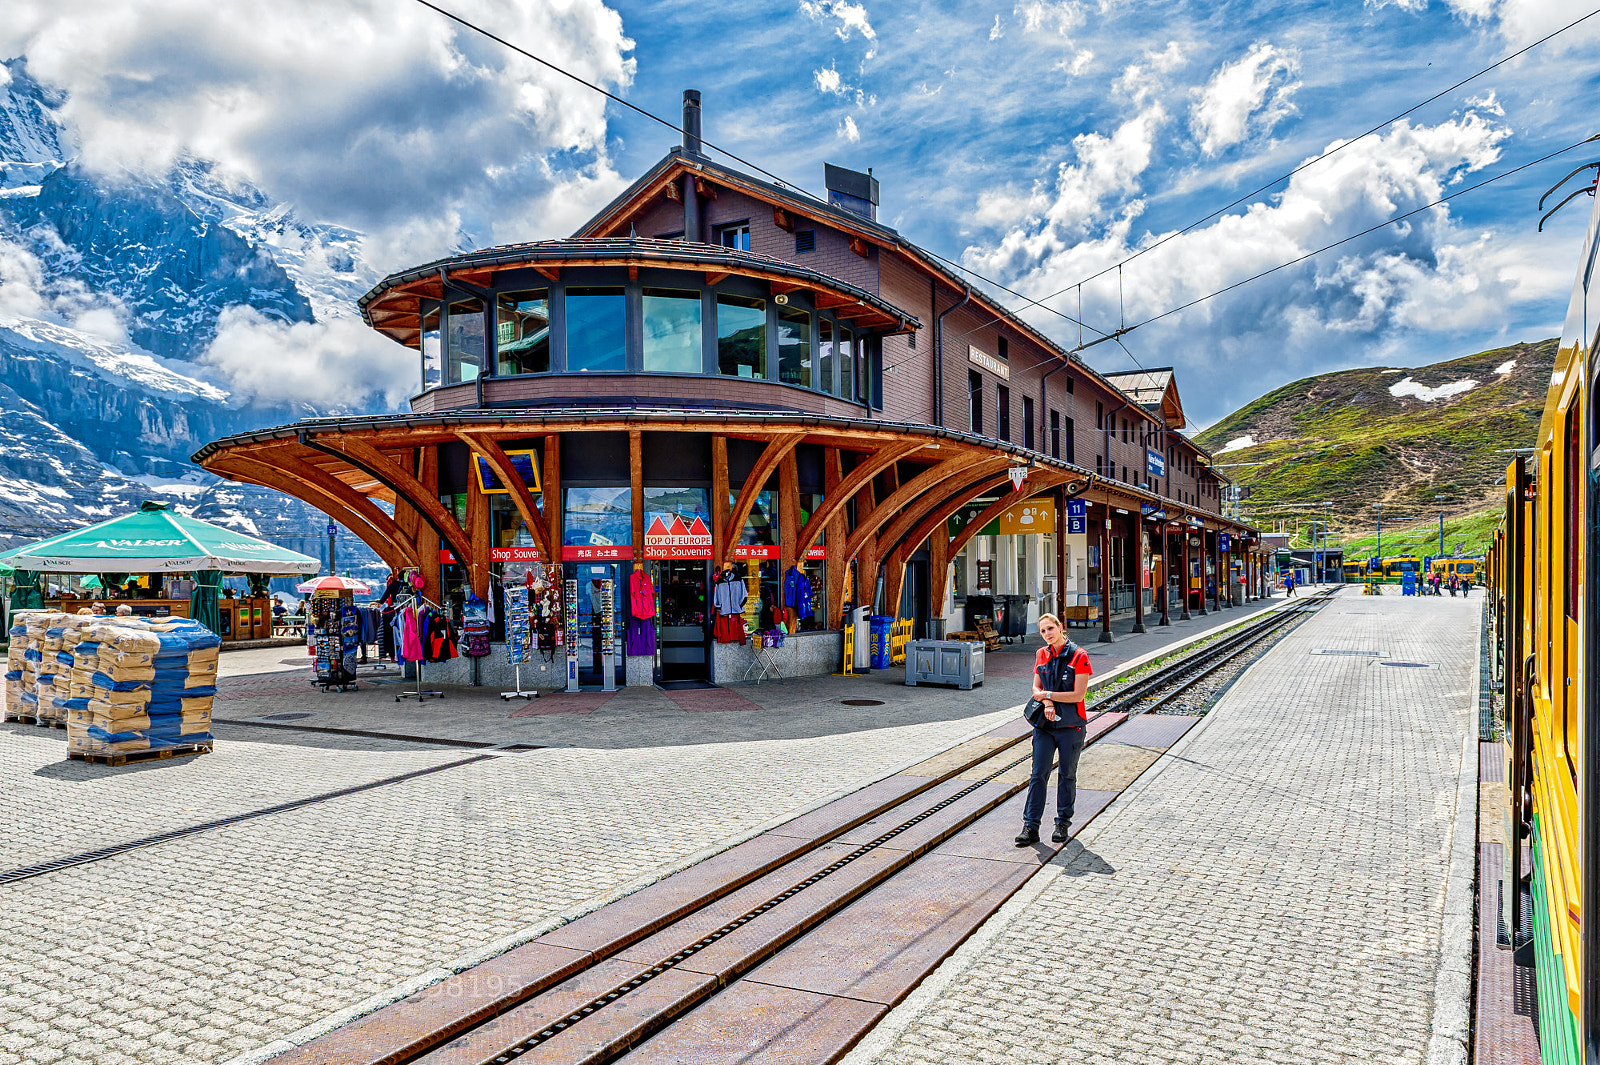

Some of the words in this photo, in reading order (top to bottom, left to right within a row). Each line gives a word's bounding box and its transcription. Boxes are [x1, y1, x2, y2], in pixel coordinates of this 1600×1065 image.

[971, 349, 1008, 378] RESTAURANT
[1072, 504, 1081, 514] 11
[1072, 520, 1080, 530] B
[109, 538, 185, 548] VALSER
[646, 537, 663, 545] TOP
[664, 537, 675, 545] OF
[678, 537, 711, 545] EUROPE
[492, 549, 511, 560] Shop
[645, 546, 668, 559] Shop
[671, 546, 712, 556] Souvenirs
